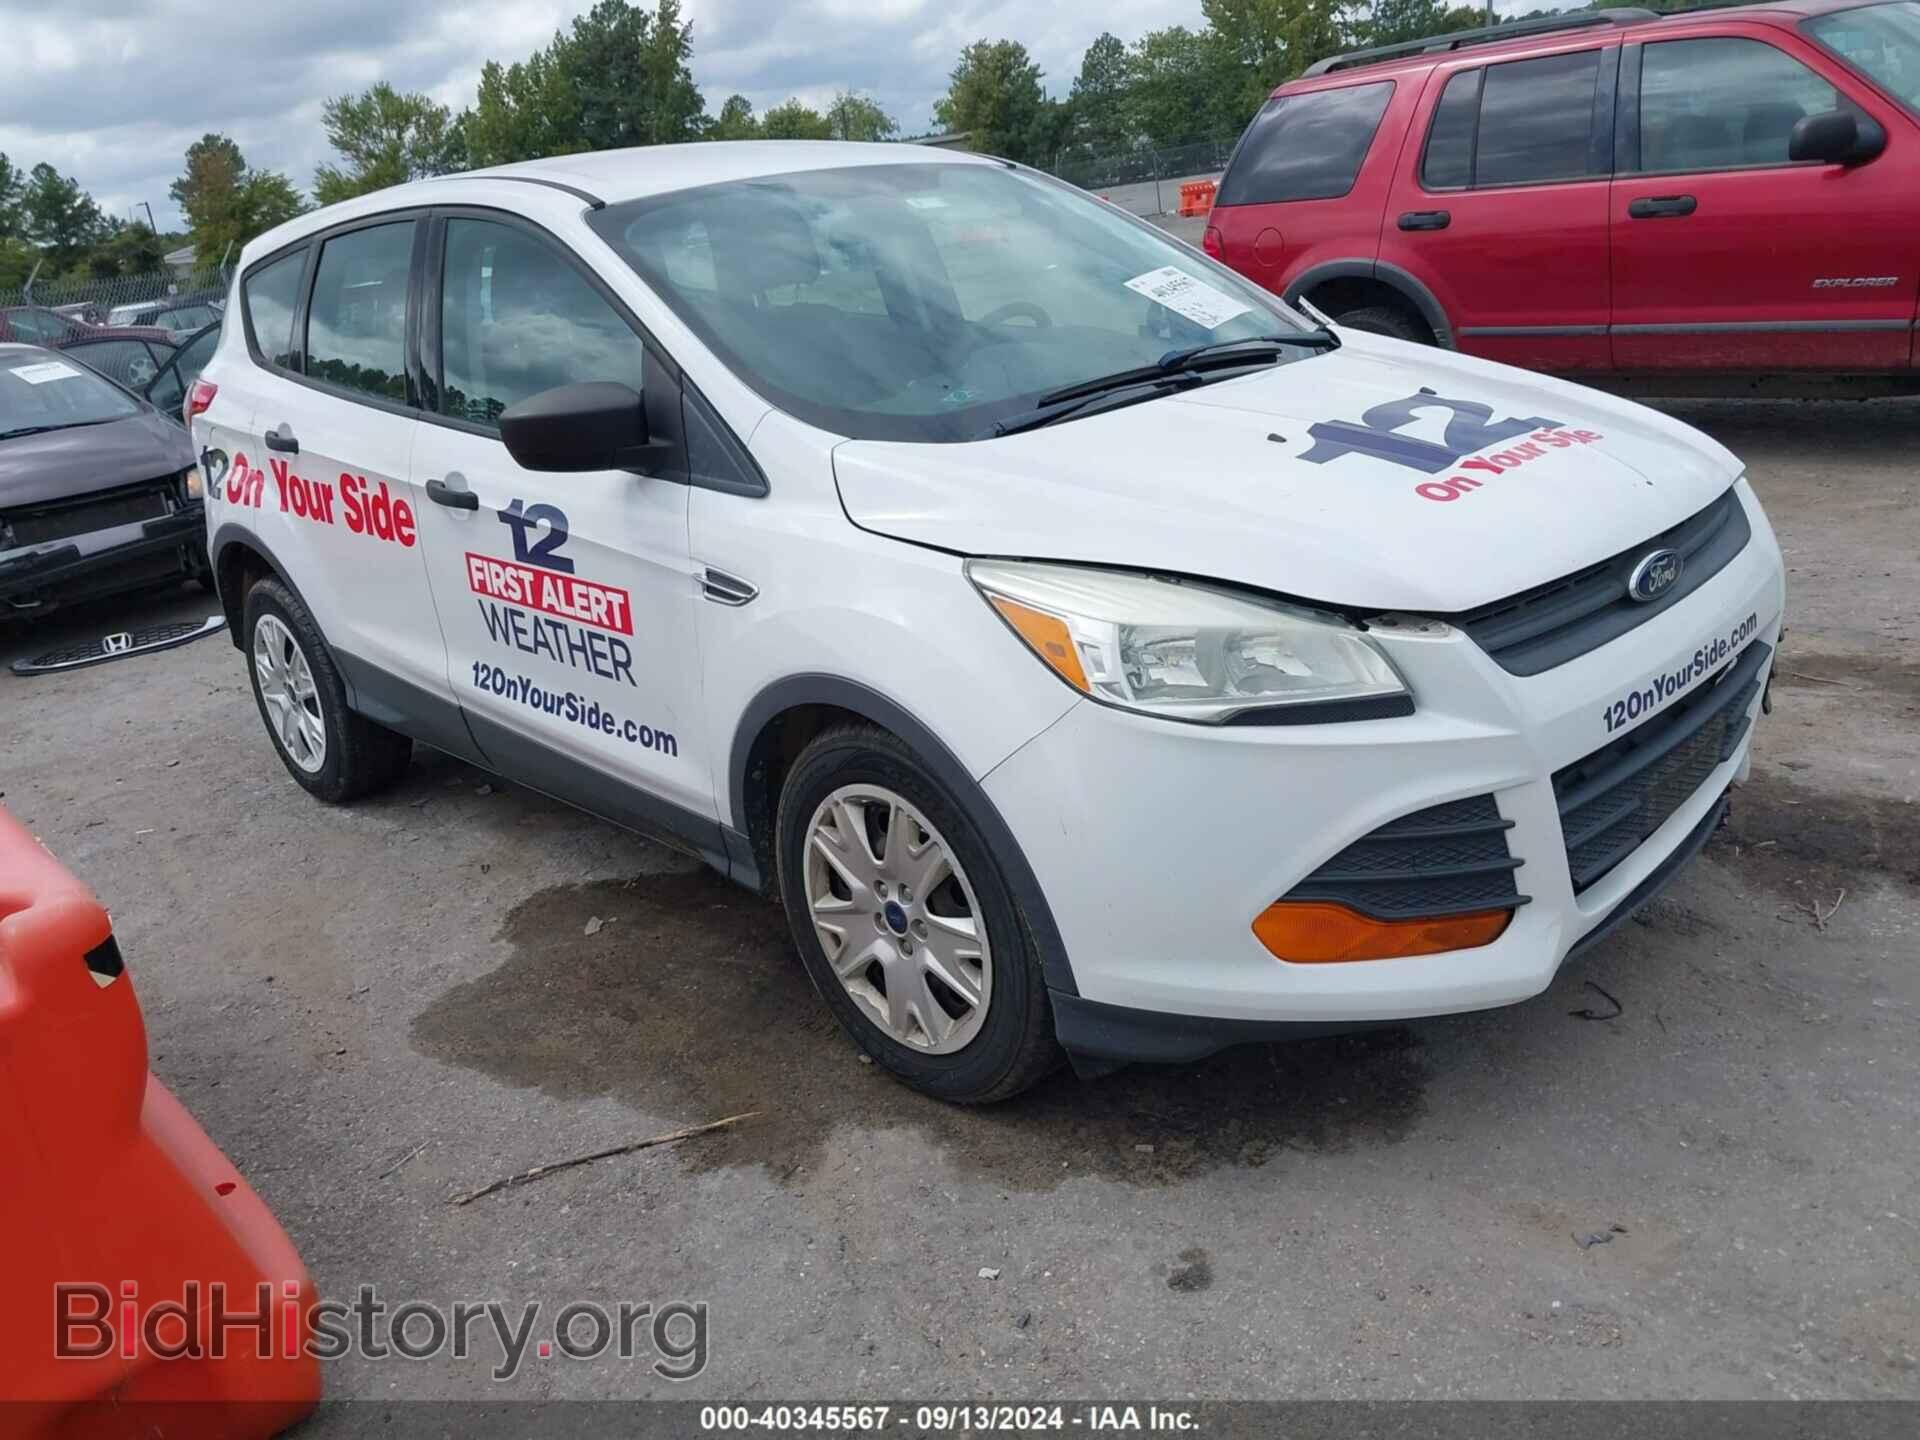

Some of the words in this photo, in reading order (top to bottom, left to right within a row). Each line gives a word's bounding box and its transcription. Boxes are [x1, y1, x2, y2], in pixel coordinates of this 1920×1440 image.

[1812, 276, 1899, 289] EXPLORER
[1295, 389, 1566, 474] 12
[1415, 474, 1483, 502] On
[1460, 439, 1553, 475] Your
[1533, 426, 1604, 449] Side
[226, 452, 265, 508] On
[269, 458, 334, 524] Your
[339, 472, 416, 547] Side
[497, 498, 575, 574] 12
[469, 557, 536, 604] FIRST
[541, 581, 626, 630] ALERT
[1649, 559, 1676, 592] Ford
[477, 598, 639, 687] WEATHER
[1603, 612, 1758, 733] 12OnYourSide.com
[472, 660, 679, 758] 12OnYourSide.com
